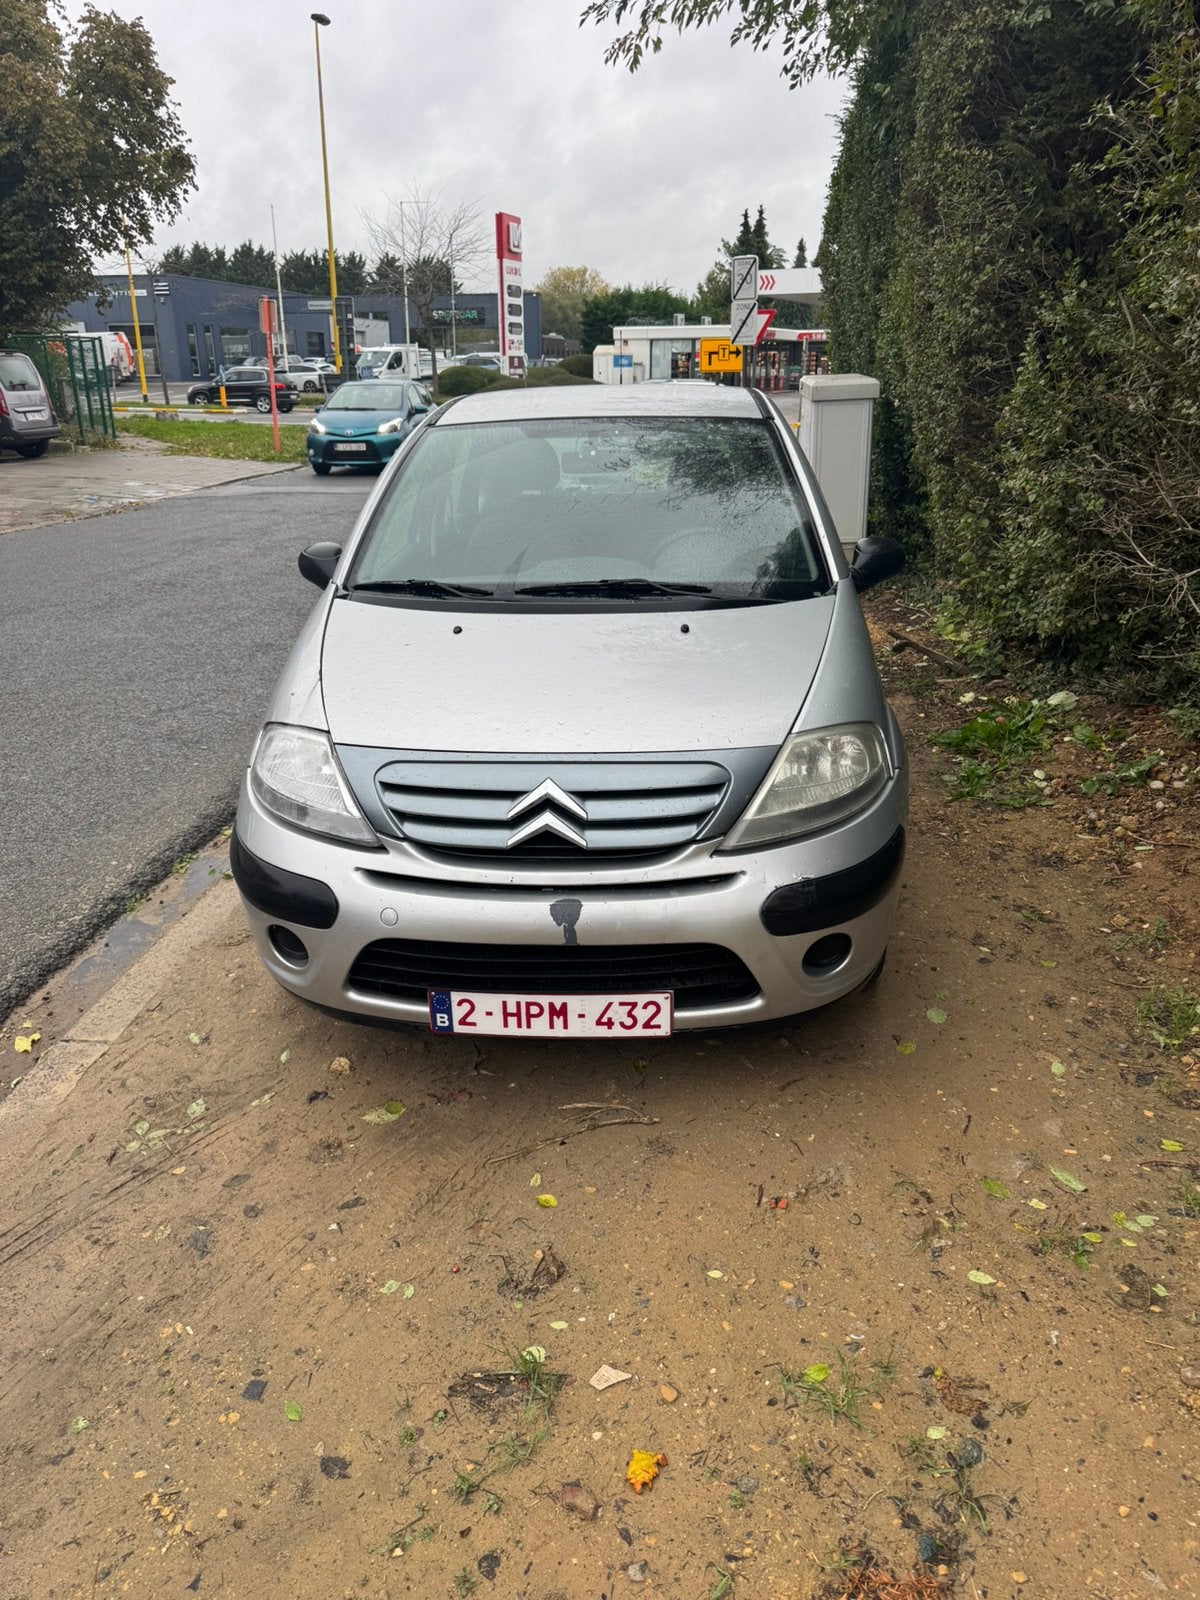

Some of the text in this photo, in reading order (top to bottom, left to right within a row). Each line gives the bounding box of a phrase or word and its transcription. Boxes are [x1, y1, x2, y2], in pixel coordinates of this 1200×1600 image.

[736, 272, 753, 285] 30
[735, 302, 752, 310] ZONE
[721, 347, 727, 358] T
[436, 1013, 449, 1027] B
[456, 998, 662, 1030] 2-HPM-432
